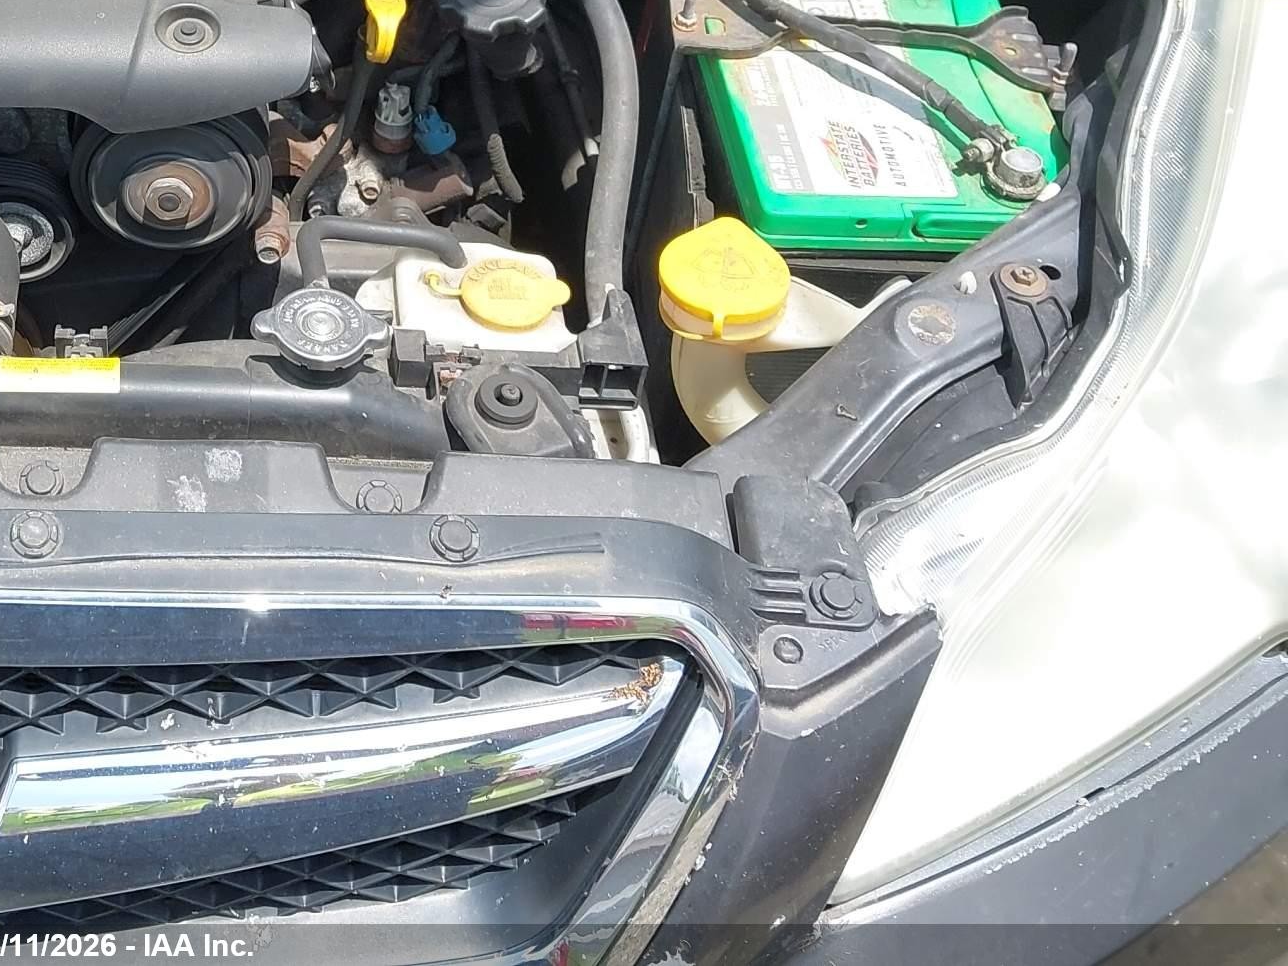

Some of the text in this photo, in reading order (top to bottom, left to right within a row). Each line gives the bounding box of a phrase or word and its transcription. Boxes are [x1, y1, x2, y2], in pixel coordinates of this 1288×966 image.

[828, 120, 861, 189] INTERSTATE
[844, 126, 875, 186] BATTERIES
[873, 124, 906, 186] AUTOMOTIVE
